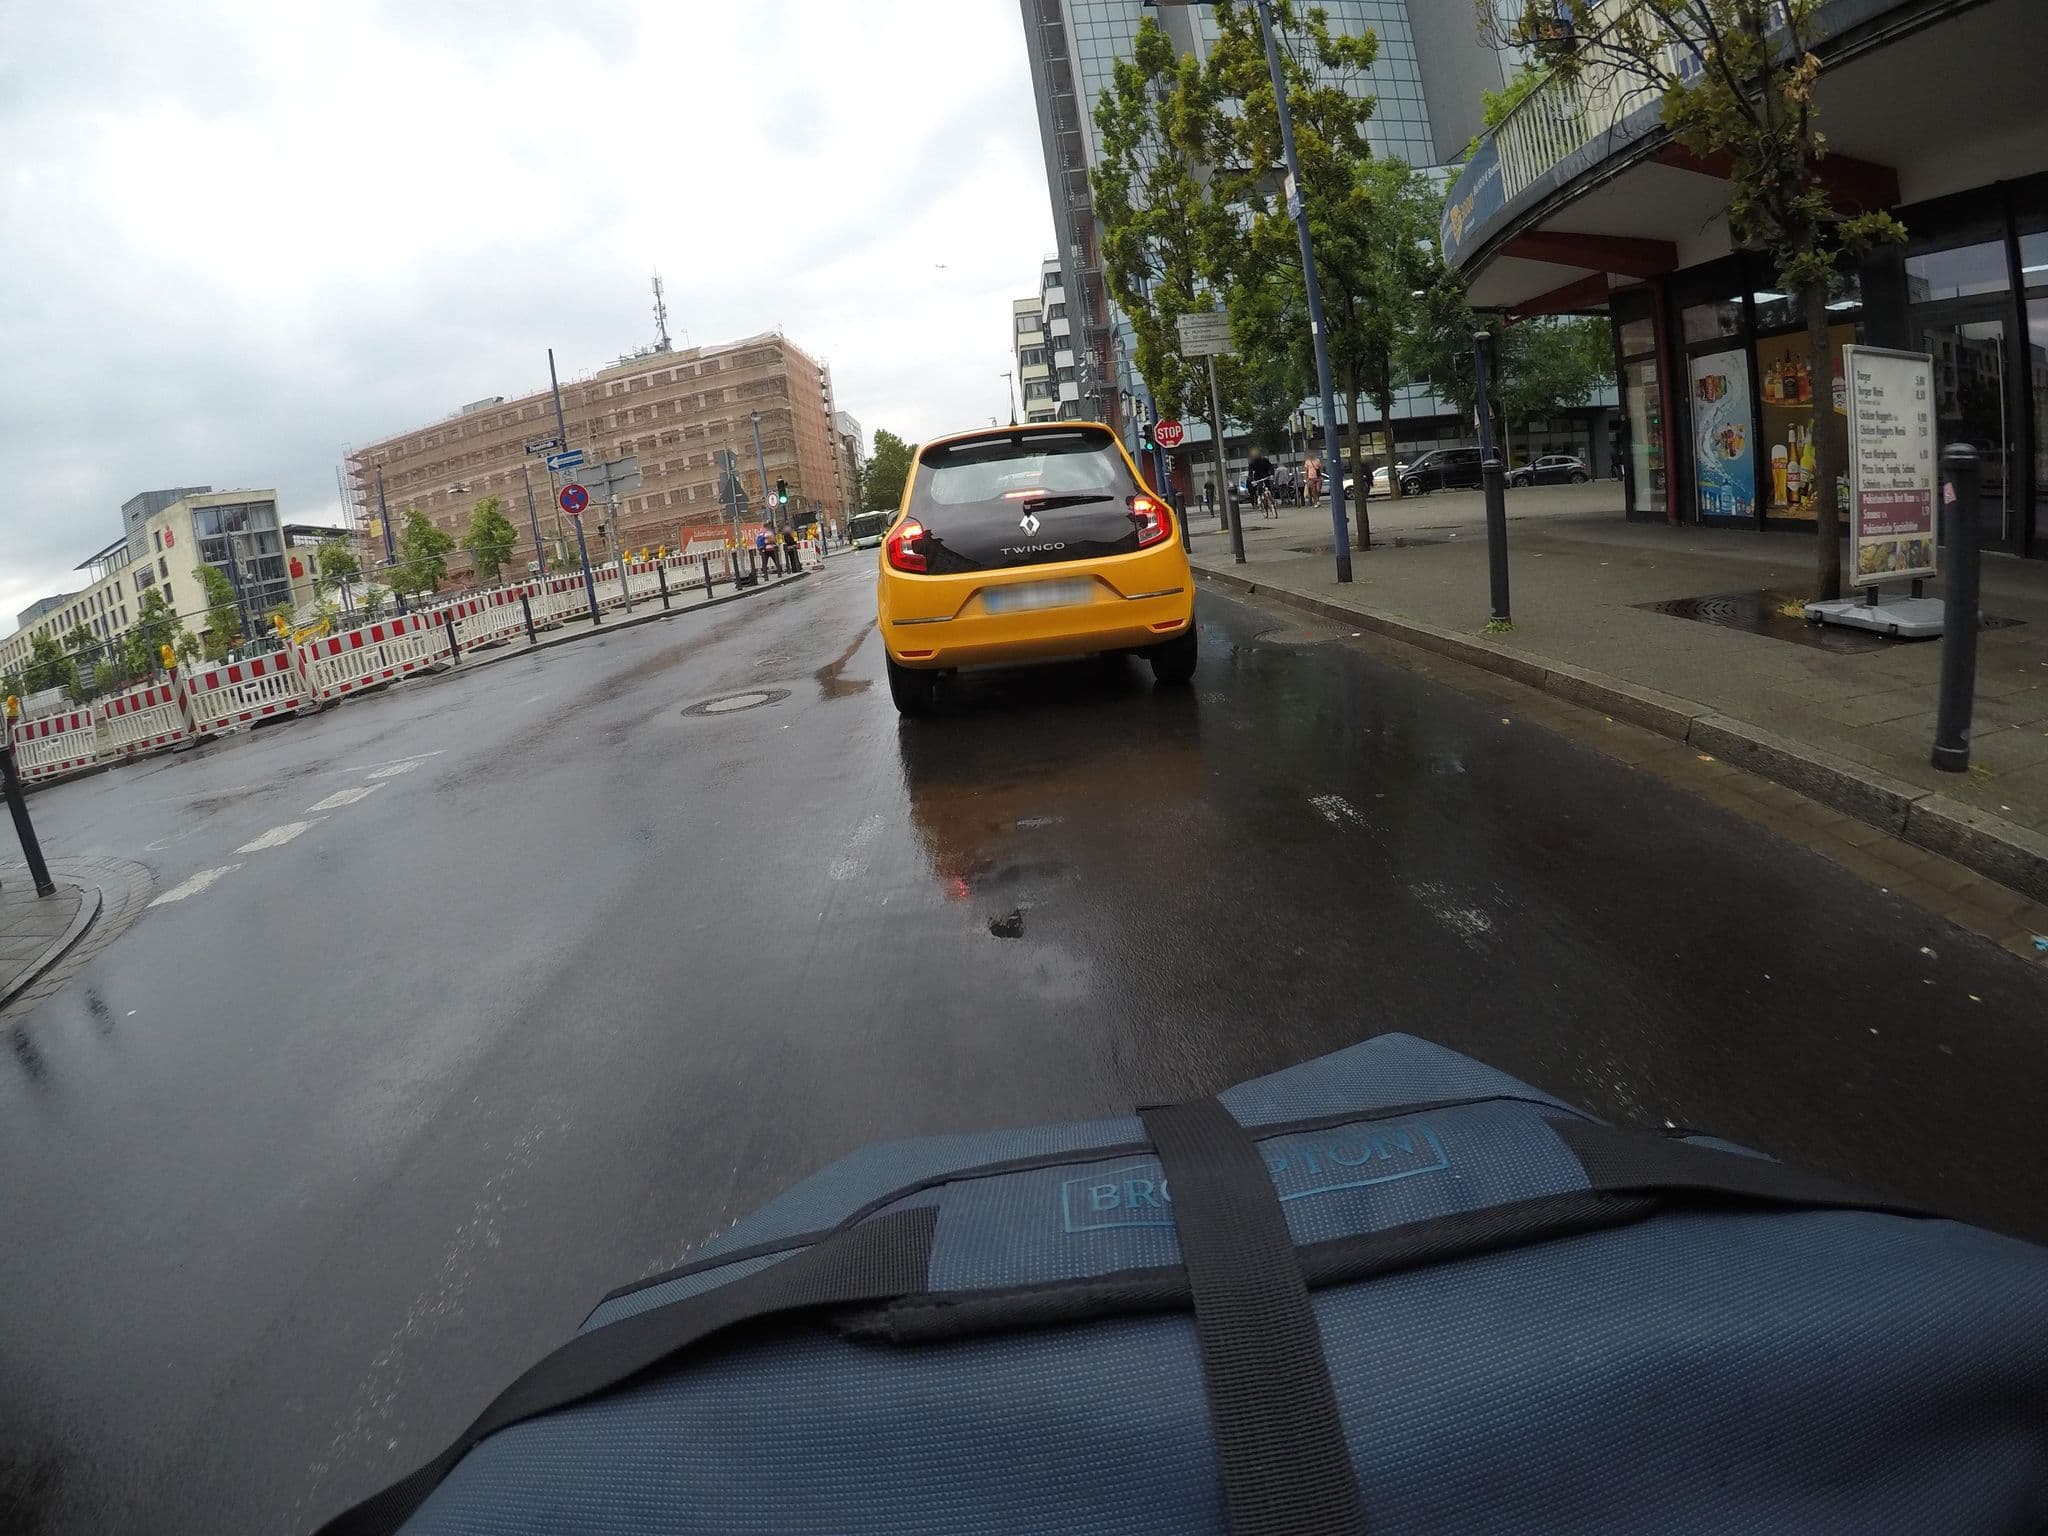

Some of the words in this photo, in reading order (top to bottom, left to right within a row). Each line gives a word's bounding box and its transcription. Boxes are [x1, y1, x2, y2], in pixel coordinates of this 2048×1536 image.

[1157, 425, 1181, 440] STOP
[999, 542, 1065, 555] TWINGO
[1088, 1129, 1414, 1211] BRPTON
